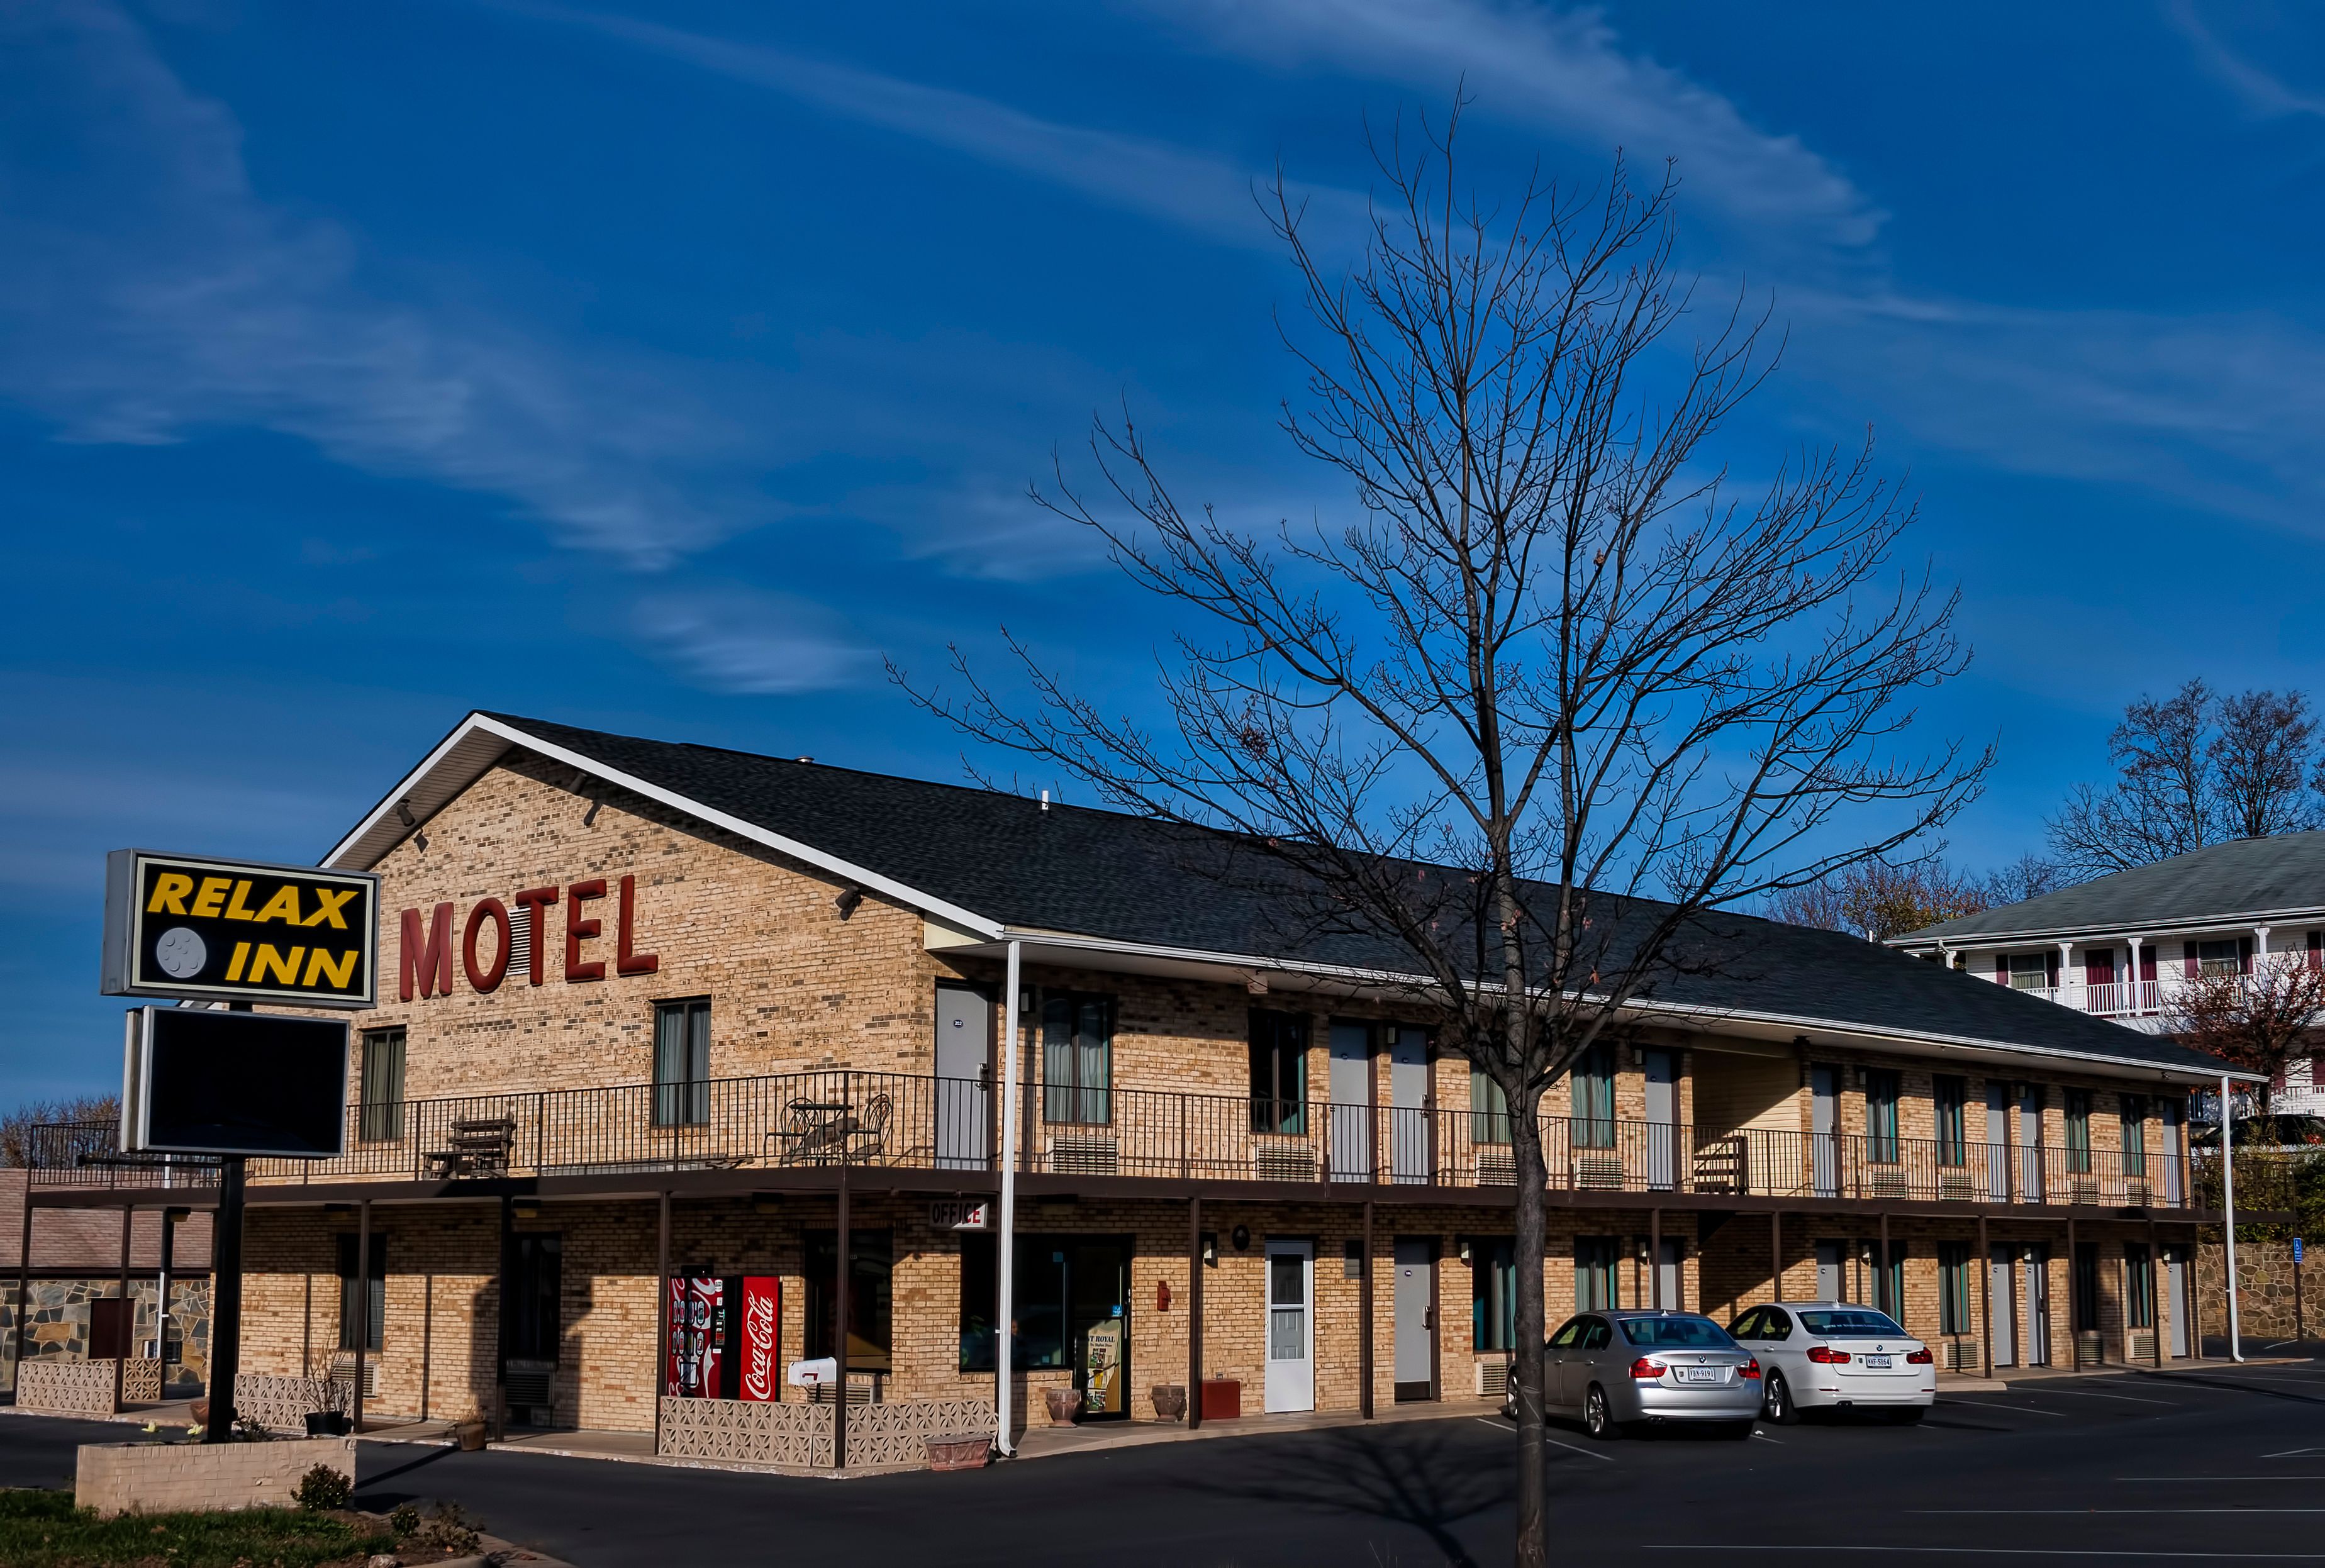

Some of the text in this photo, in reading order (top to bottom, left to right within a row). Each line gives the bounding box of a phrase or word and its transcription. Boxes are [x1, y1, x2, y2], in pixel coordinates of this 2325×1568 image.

[147, 872, 358, 929] RELAX
[225, 941, 359, 988] INN
[399, 874, 659, 1002] MOTEL
[932, 1203, 981, 1225] OFFICE
[745, 1290, 773, 1399] Coca-Cola
